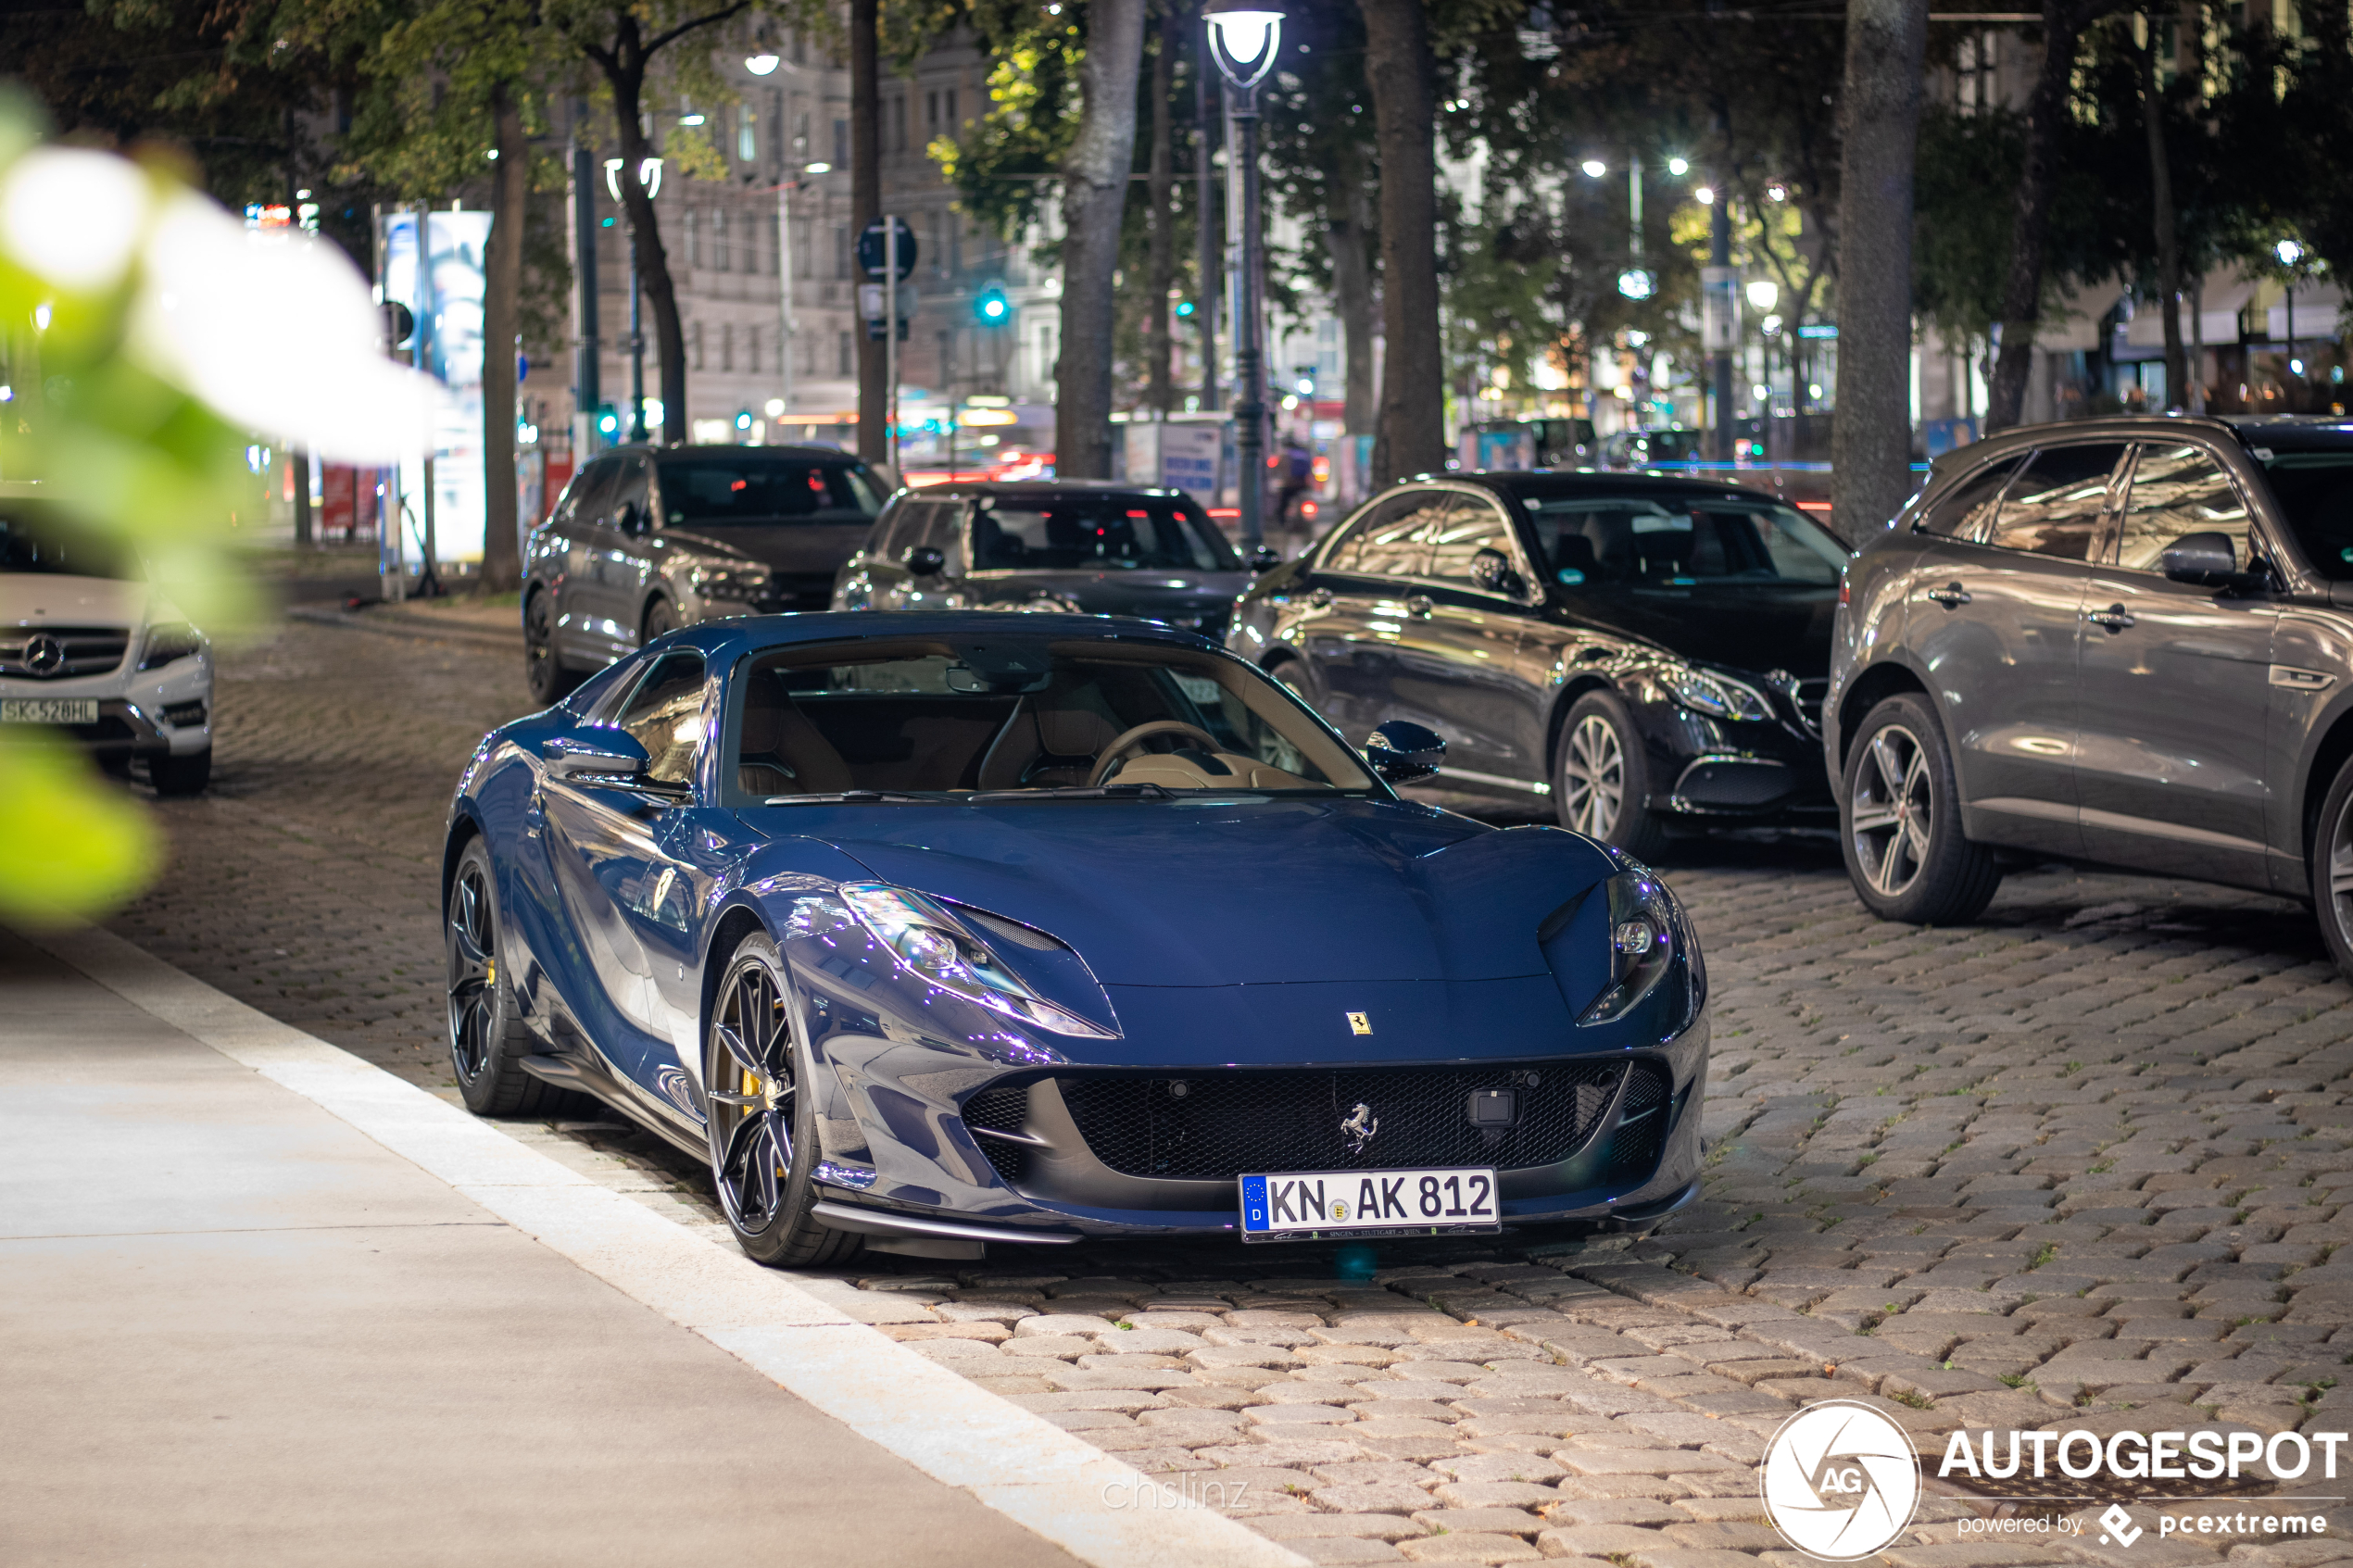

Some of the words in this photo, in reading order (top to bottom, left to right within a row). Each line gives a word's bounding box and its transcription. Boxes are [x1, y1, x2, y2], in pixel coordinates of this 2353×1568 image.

[1270, 1180, 1326, 1223] KN
[1357, 1177, 1408, 1219] AK
[1419, 1175, 1492, 1217] 812
[1252, 1209, 1262, 1221] D
